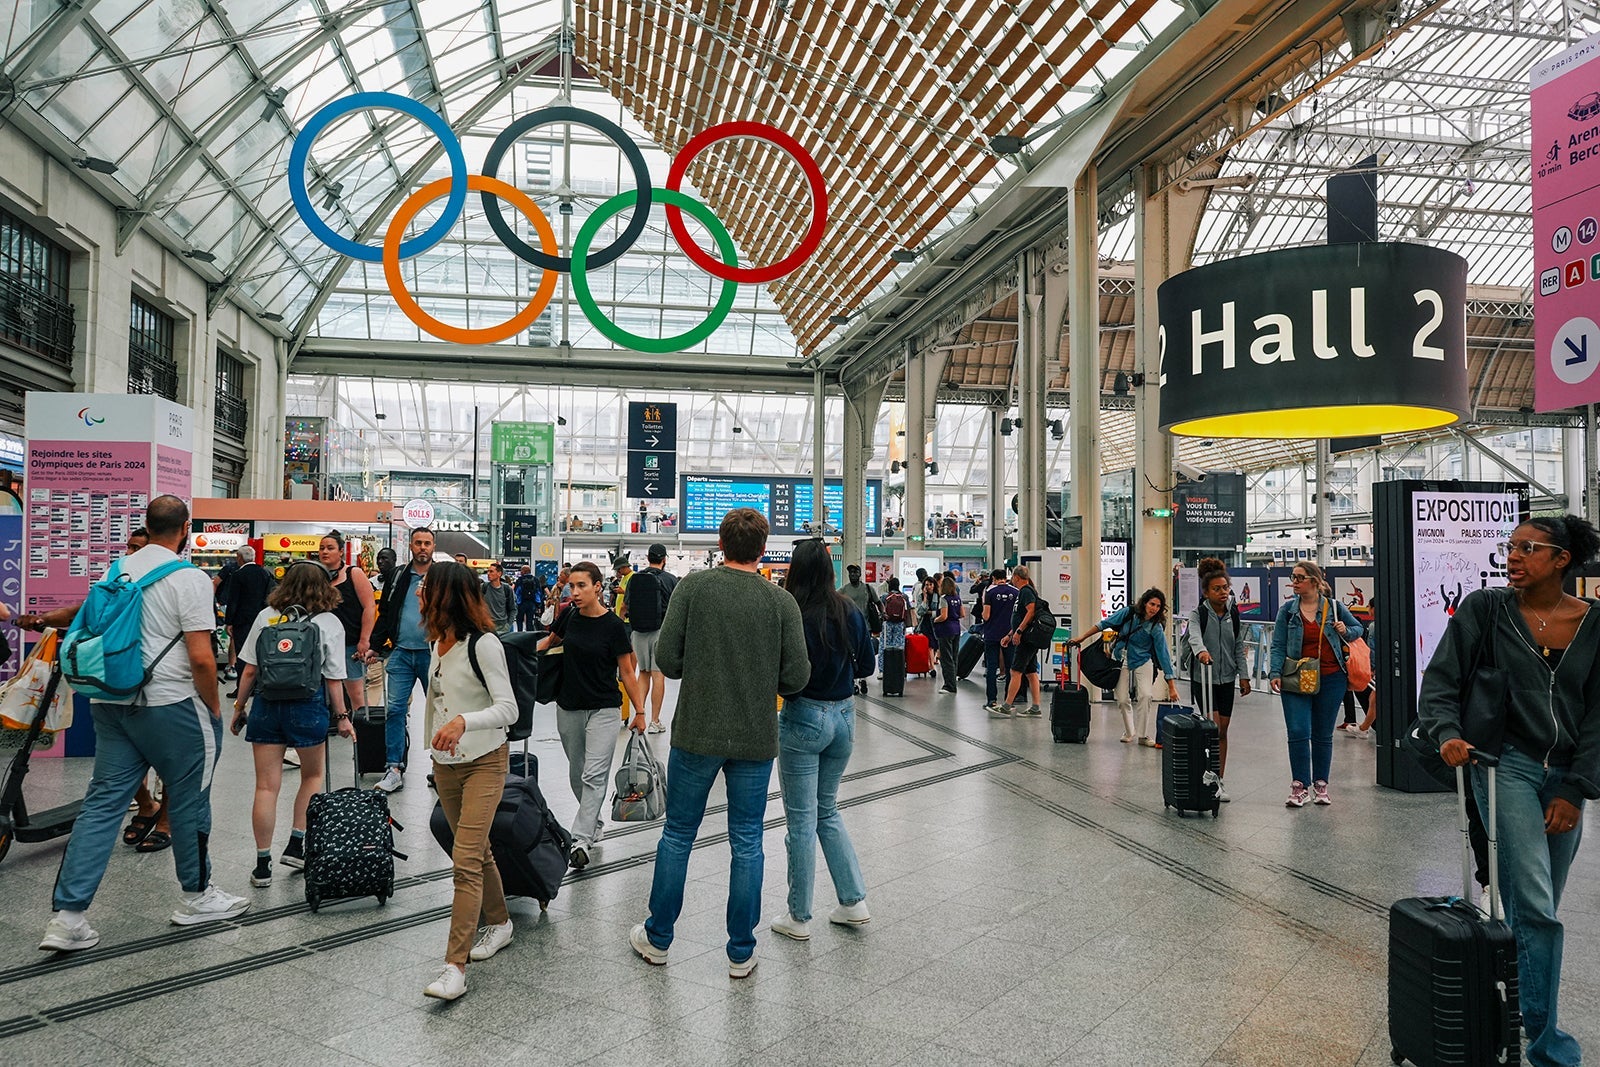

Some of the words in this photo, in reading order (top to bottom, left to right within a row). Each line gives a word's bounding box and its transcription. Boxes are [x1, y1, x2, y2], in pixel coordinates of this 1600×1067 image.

[1551, 55, 1573, 71] PARIS
[1574, 46, 1595, 60] 2024
[1537, 170, 1546, 179] 10
[1547, 164, 1562, 175] min
[1556, 231, 1567, 249] M
[1579, 222, 1595, 240] 14
[1542, 275, 1558, 289] RER
[1569, 266, 1581, 283] A
[1191, 286, 1376, 376] Hall
[1412, 288, 1446, 361] 2
[31, 450, 75, 459] Rejoindre
[77, 450, 90, 459] les
[92, 450, 113, 459] sites
[31, 460, 84, 470] Olympiques
[100, 461, 122, 469] Paris
[124, 461, 146, 469] 2024
[408, 509, 430, 519] ROLLS
[1416, 499, 1514, 522] EXPOSITION
[204, 524, 221, 534] LOSE
[1418, 528, 1445, 538] AVIGNON
[1461, 529, 1482, 538] PALAIS
[1482, 530, 1495, 538] DES
[902, 561, 918, 569] Plus
